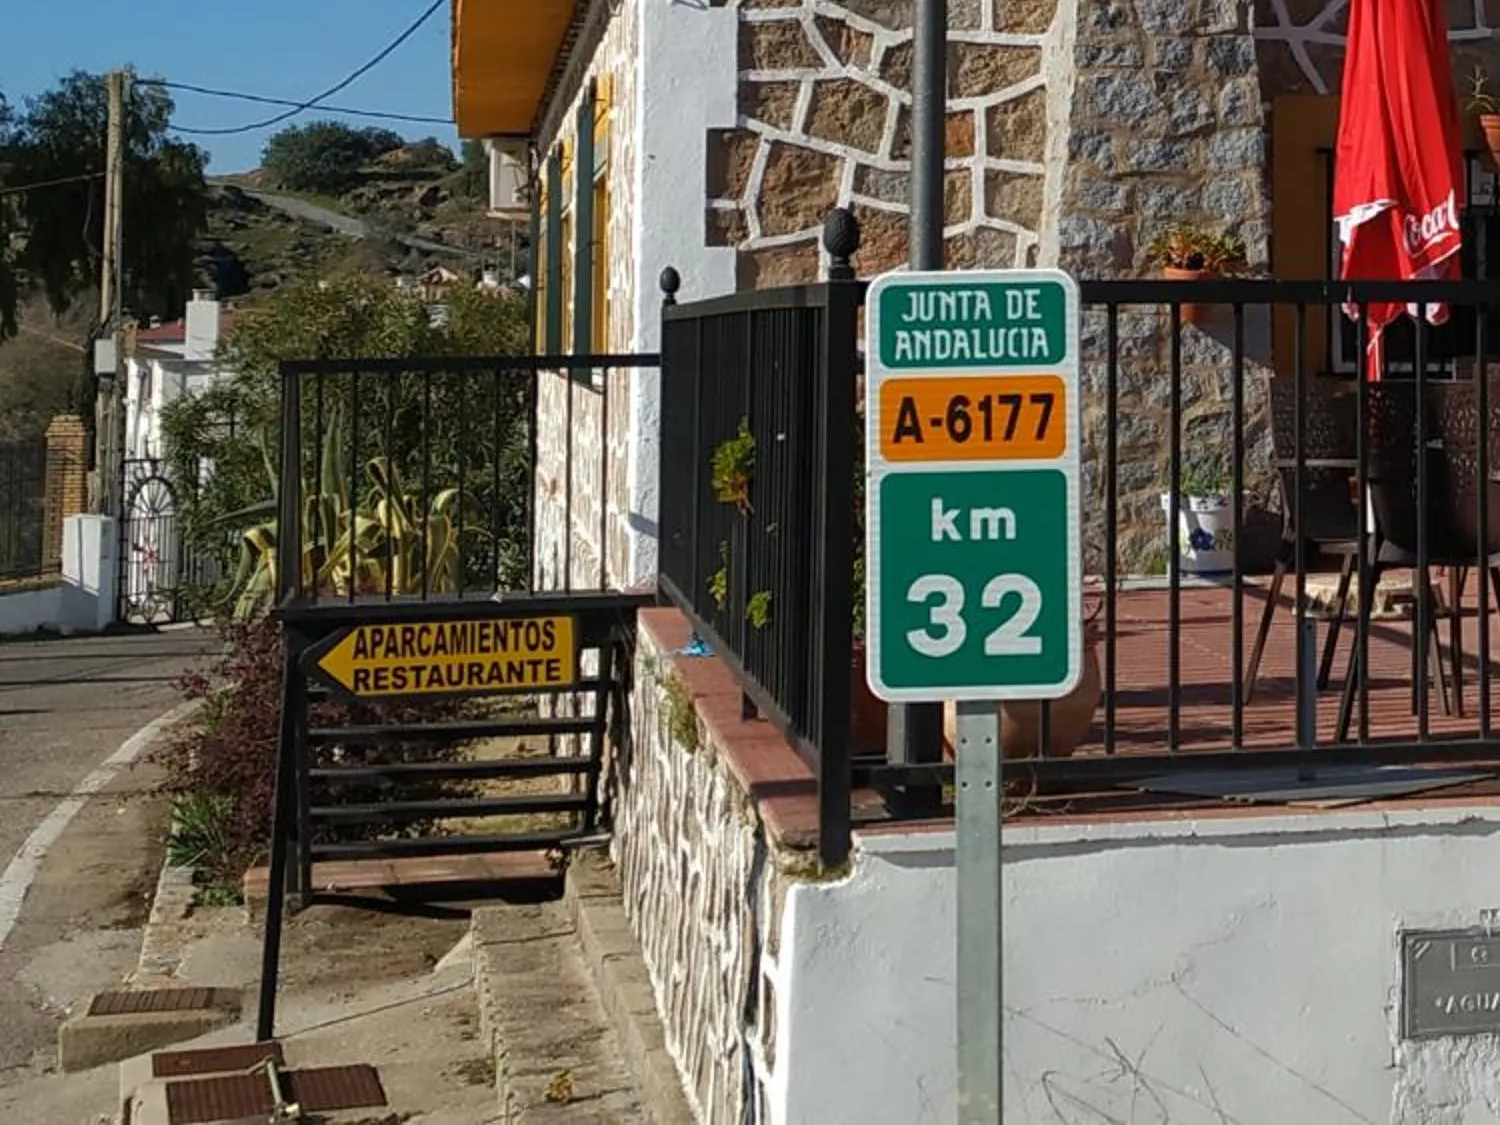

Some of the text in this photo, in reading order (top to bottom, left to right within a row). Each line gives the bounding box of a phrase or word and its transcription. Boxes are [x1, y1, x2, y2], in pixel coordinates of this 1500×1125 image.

[902, 289, 1041, 322] JUNTA DE
[894, 327, 1050, 361] ANDALUCIA
[892, 393, 1055, 444] A-6177
[930, 498, 1017, 542] km
[905, 573, 1043, 658] 32
[352, 619, 556, 661] APARCAMIENTOS
[353, 658, 561, 692] RESTAURANTE
